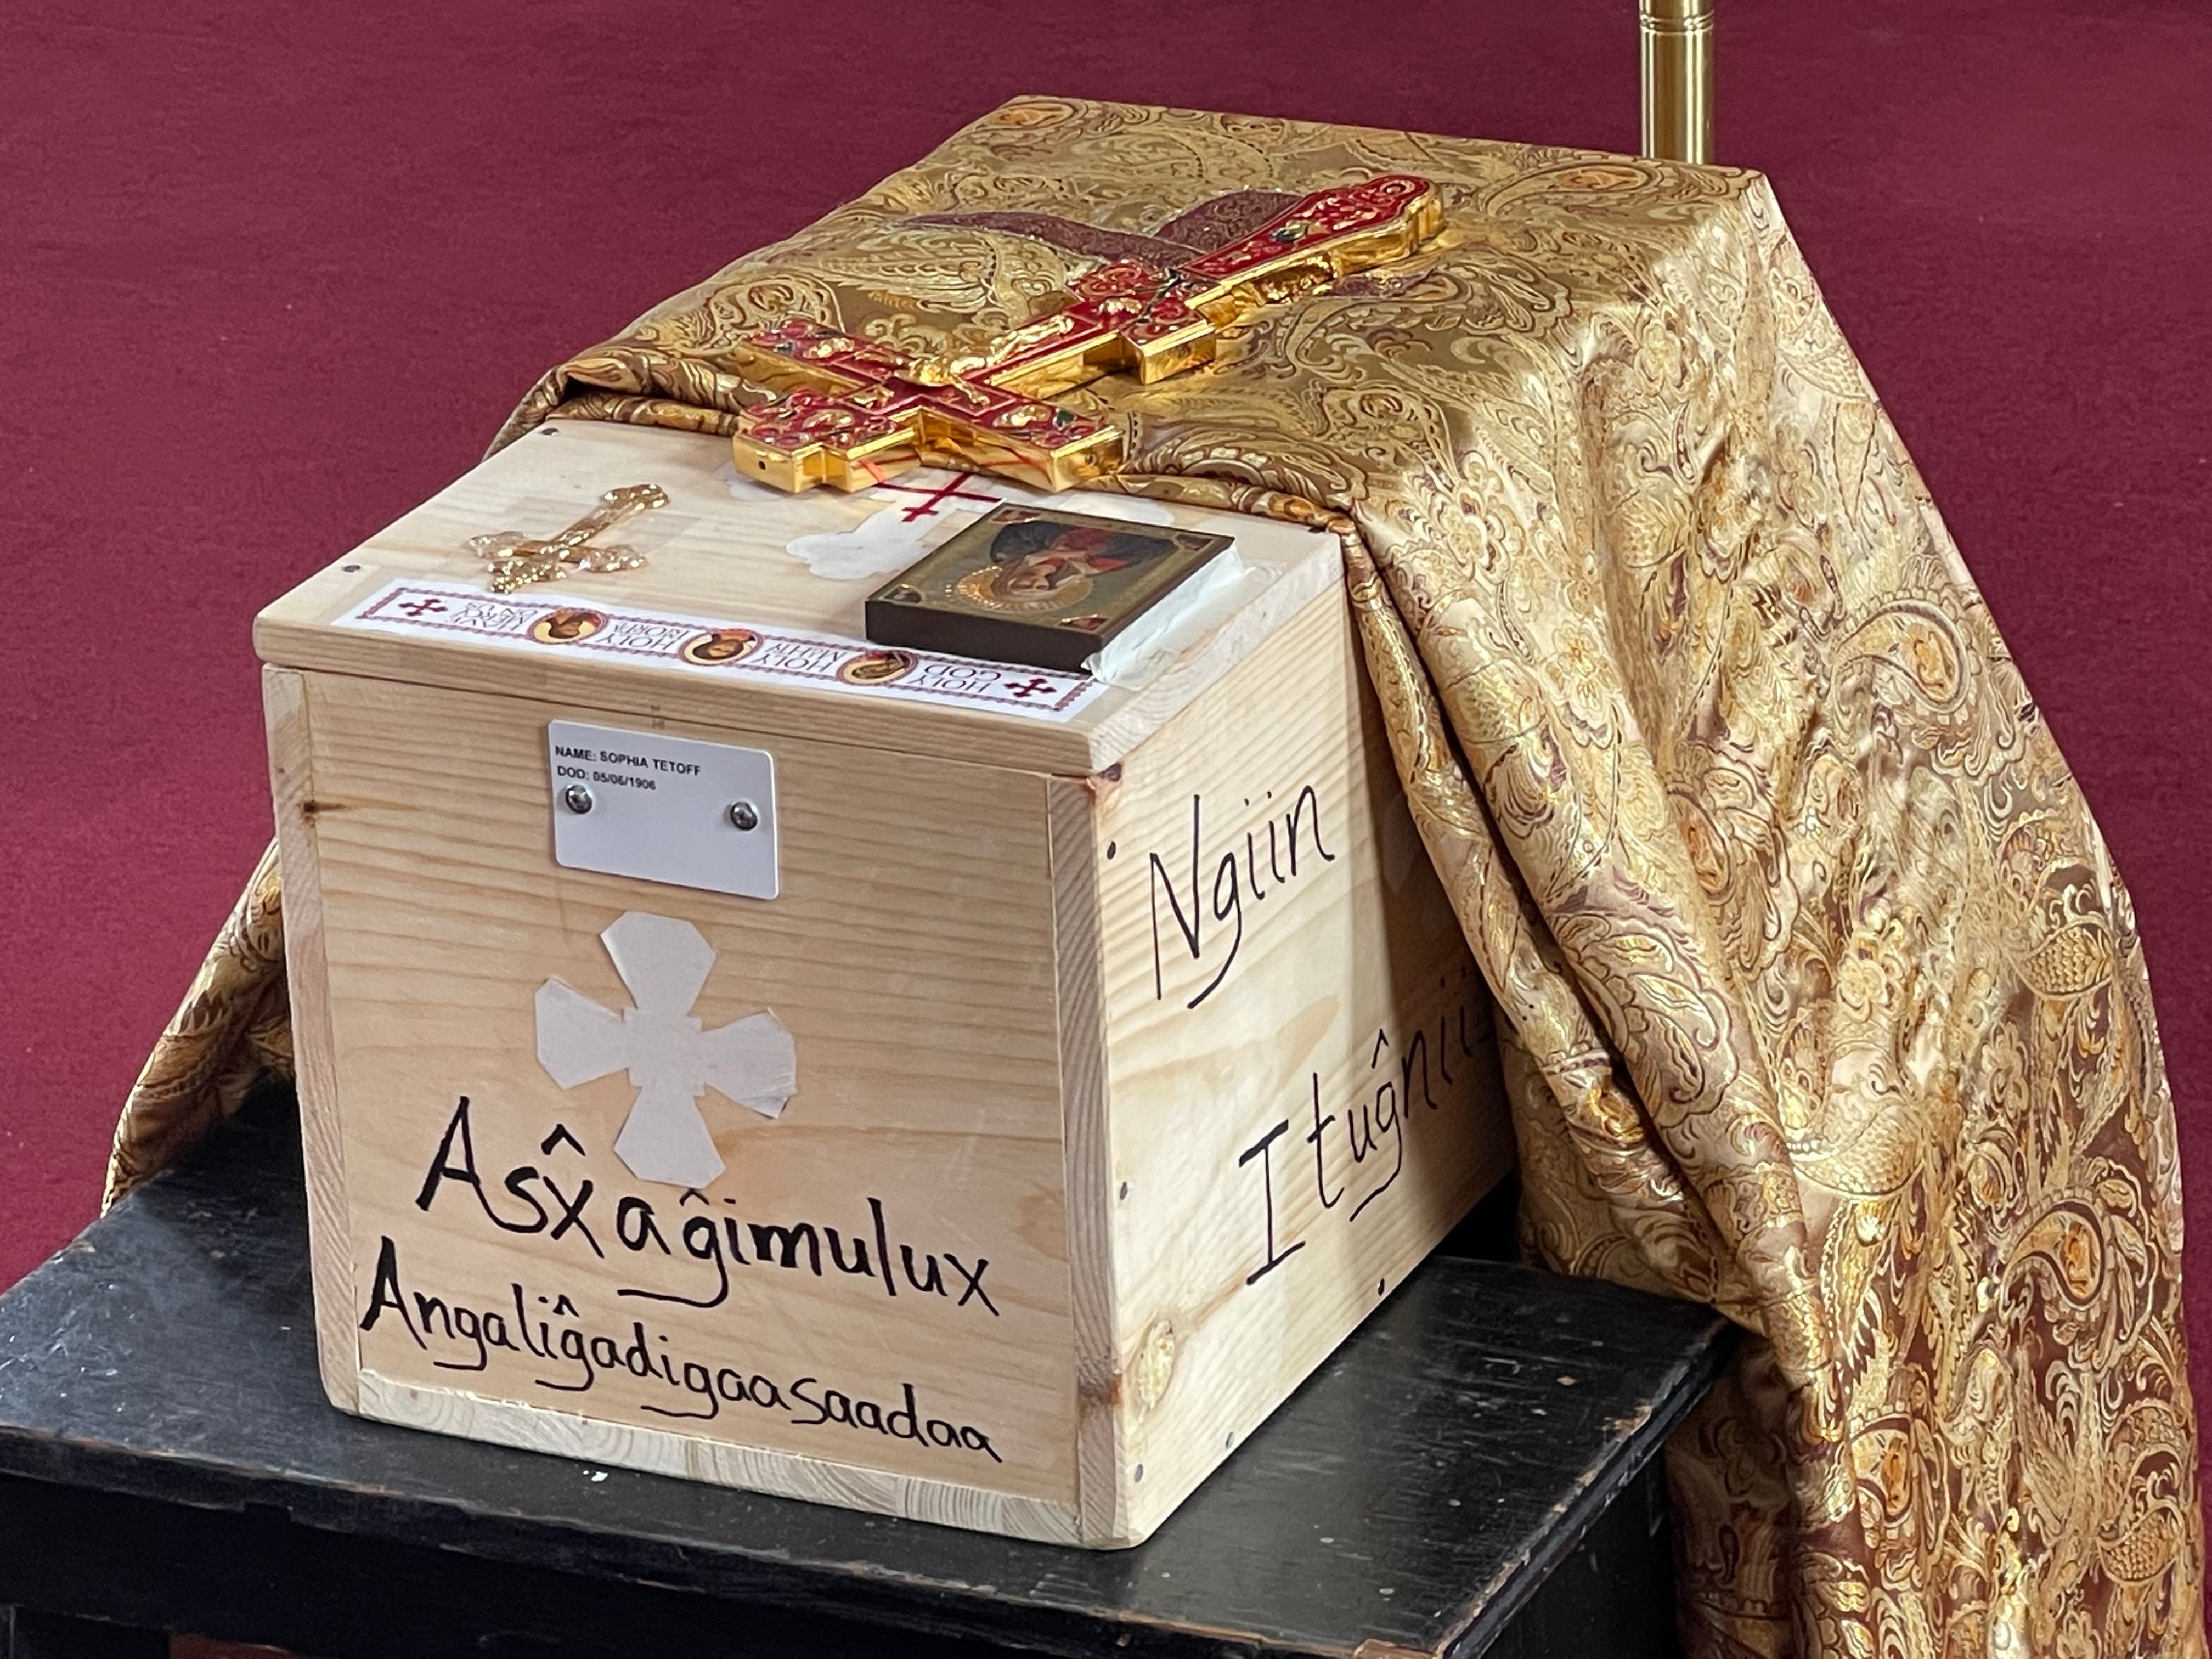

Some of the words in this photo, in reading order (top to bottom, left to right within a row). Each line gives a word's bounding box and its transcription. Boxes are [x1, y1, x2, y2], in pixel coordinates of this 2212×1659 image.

[597, 633, 676, 650] HOLY
[756, 653, 833, 672] HOLY
[924, 664, 1002, 682] GOD
[906, 675, 991, 693] HOLY
[555, 745, 597, 762] NAME:
[599, 751, 649, 769] SOPHIA
[652, 758, 702, 776] TETOFF
[557, 765, 590, 780] DOD:
[1149, 785, 1335, 1009] Ngiin
[1238, 964, 1491, 1285] Ituĝnii
